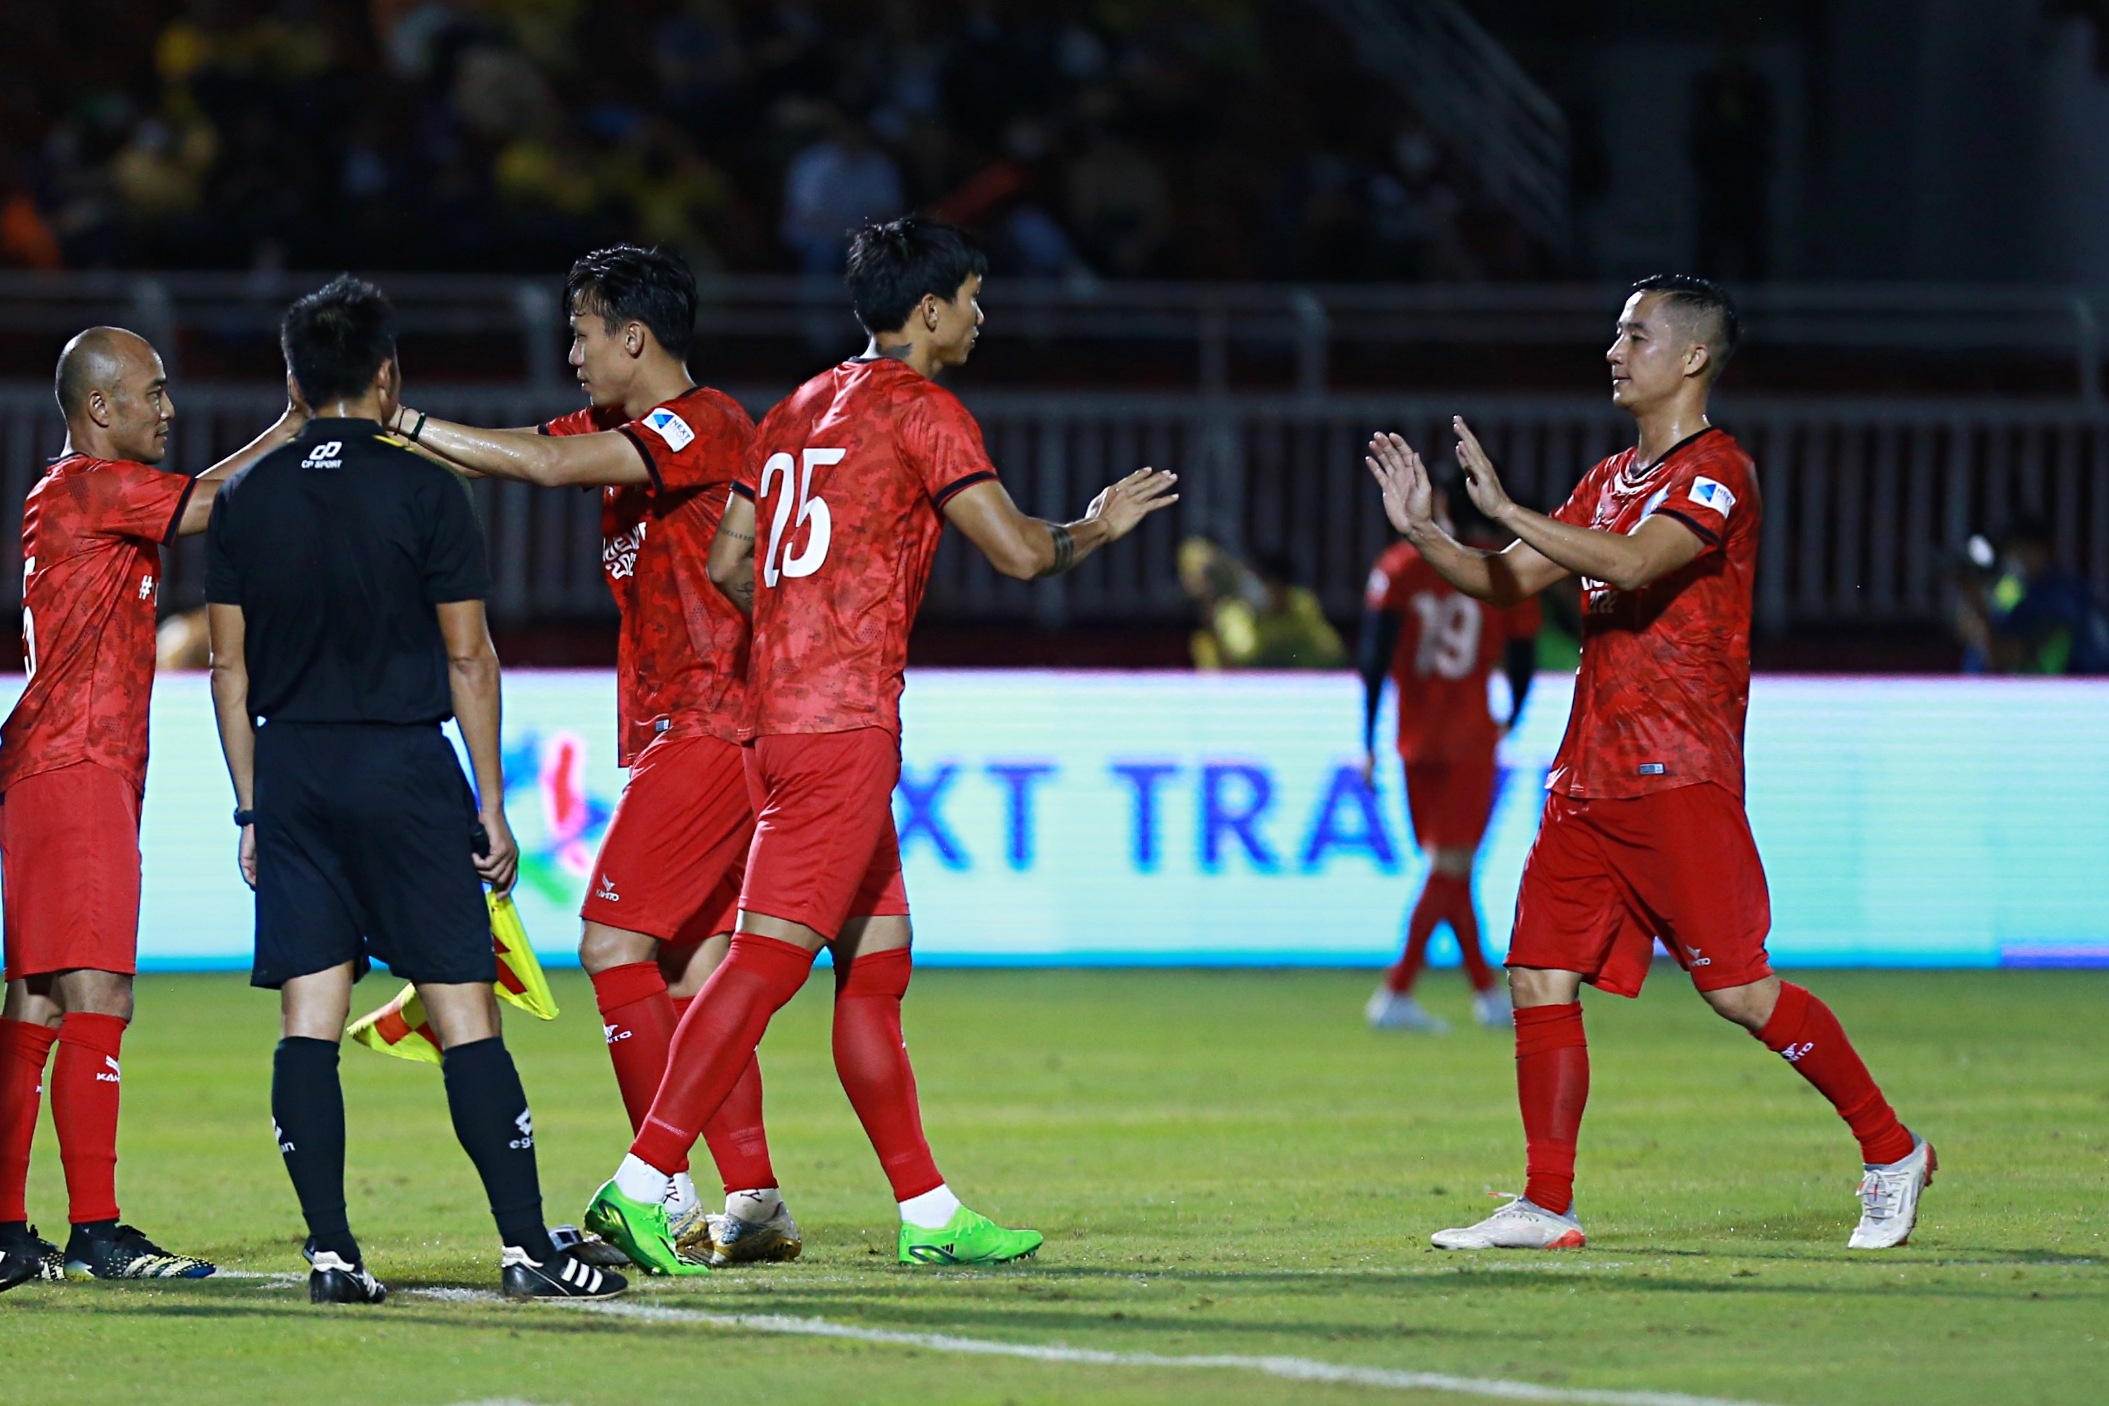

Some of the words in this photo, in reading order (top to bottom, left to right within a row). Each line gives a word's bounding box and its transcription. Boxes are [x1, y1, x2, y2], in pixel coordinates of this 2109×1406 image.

[760, 447, 846, 588] 25
[1411, 592, 1481, 680] 19
[1108, 760, 1550, 872] TRA
